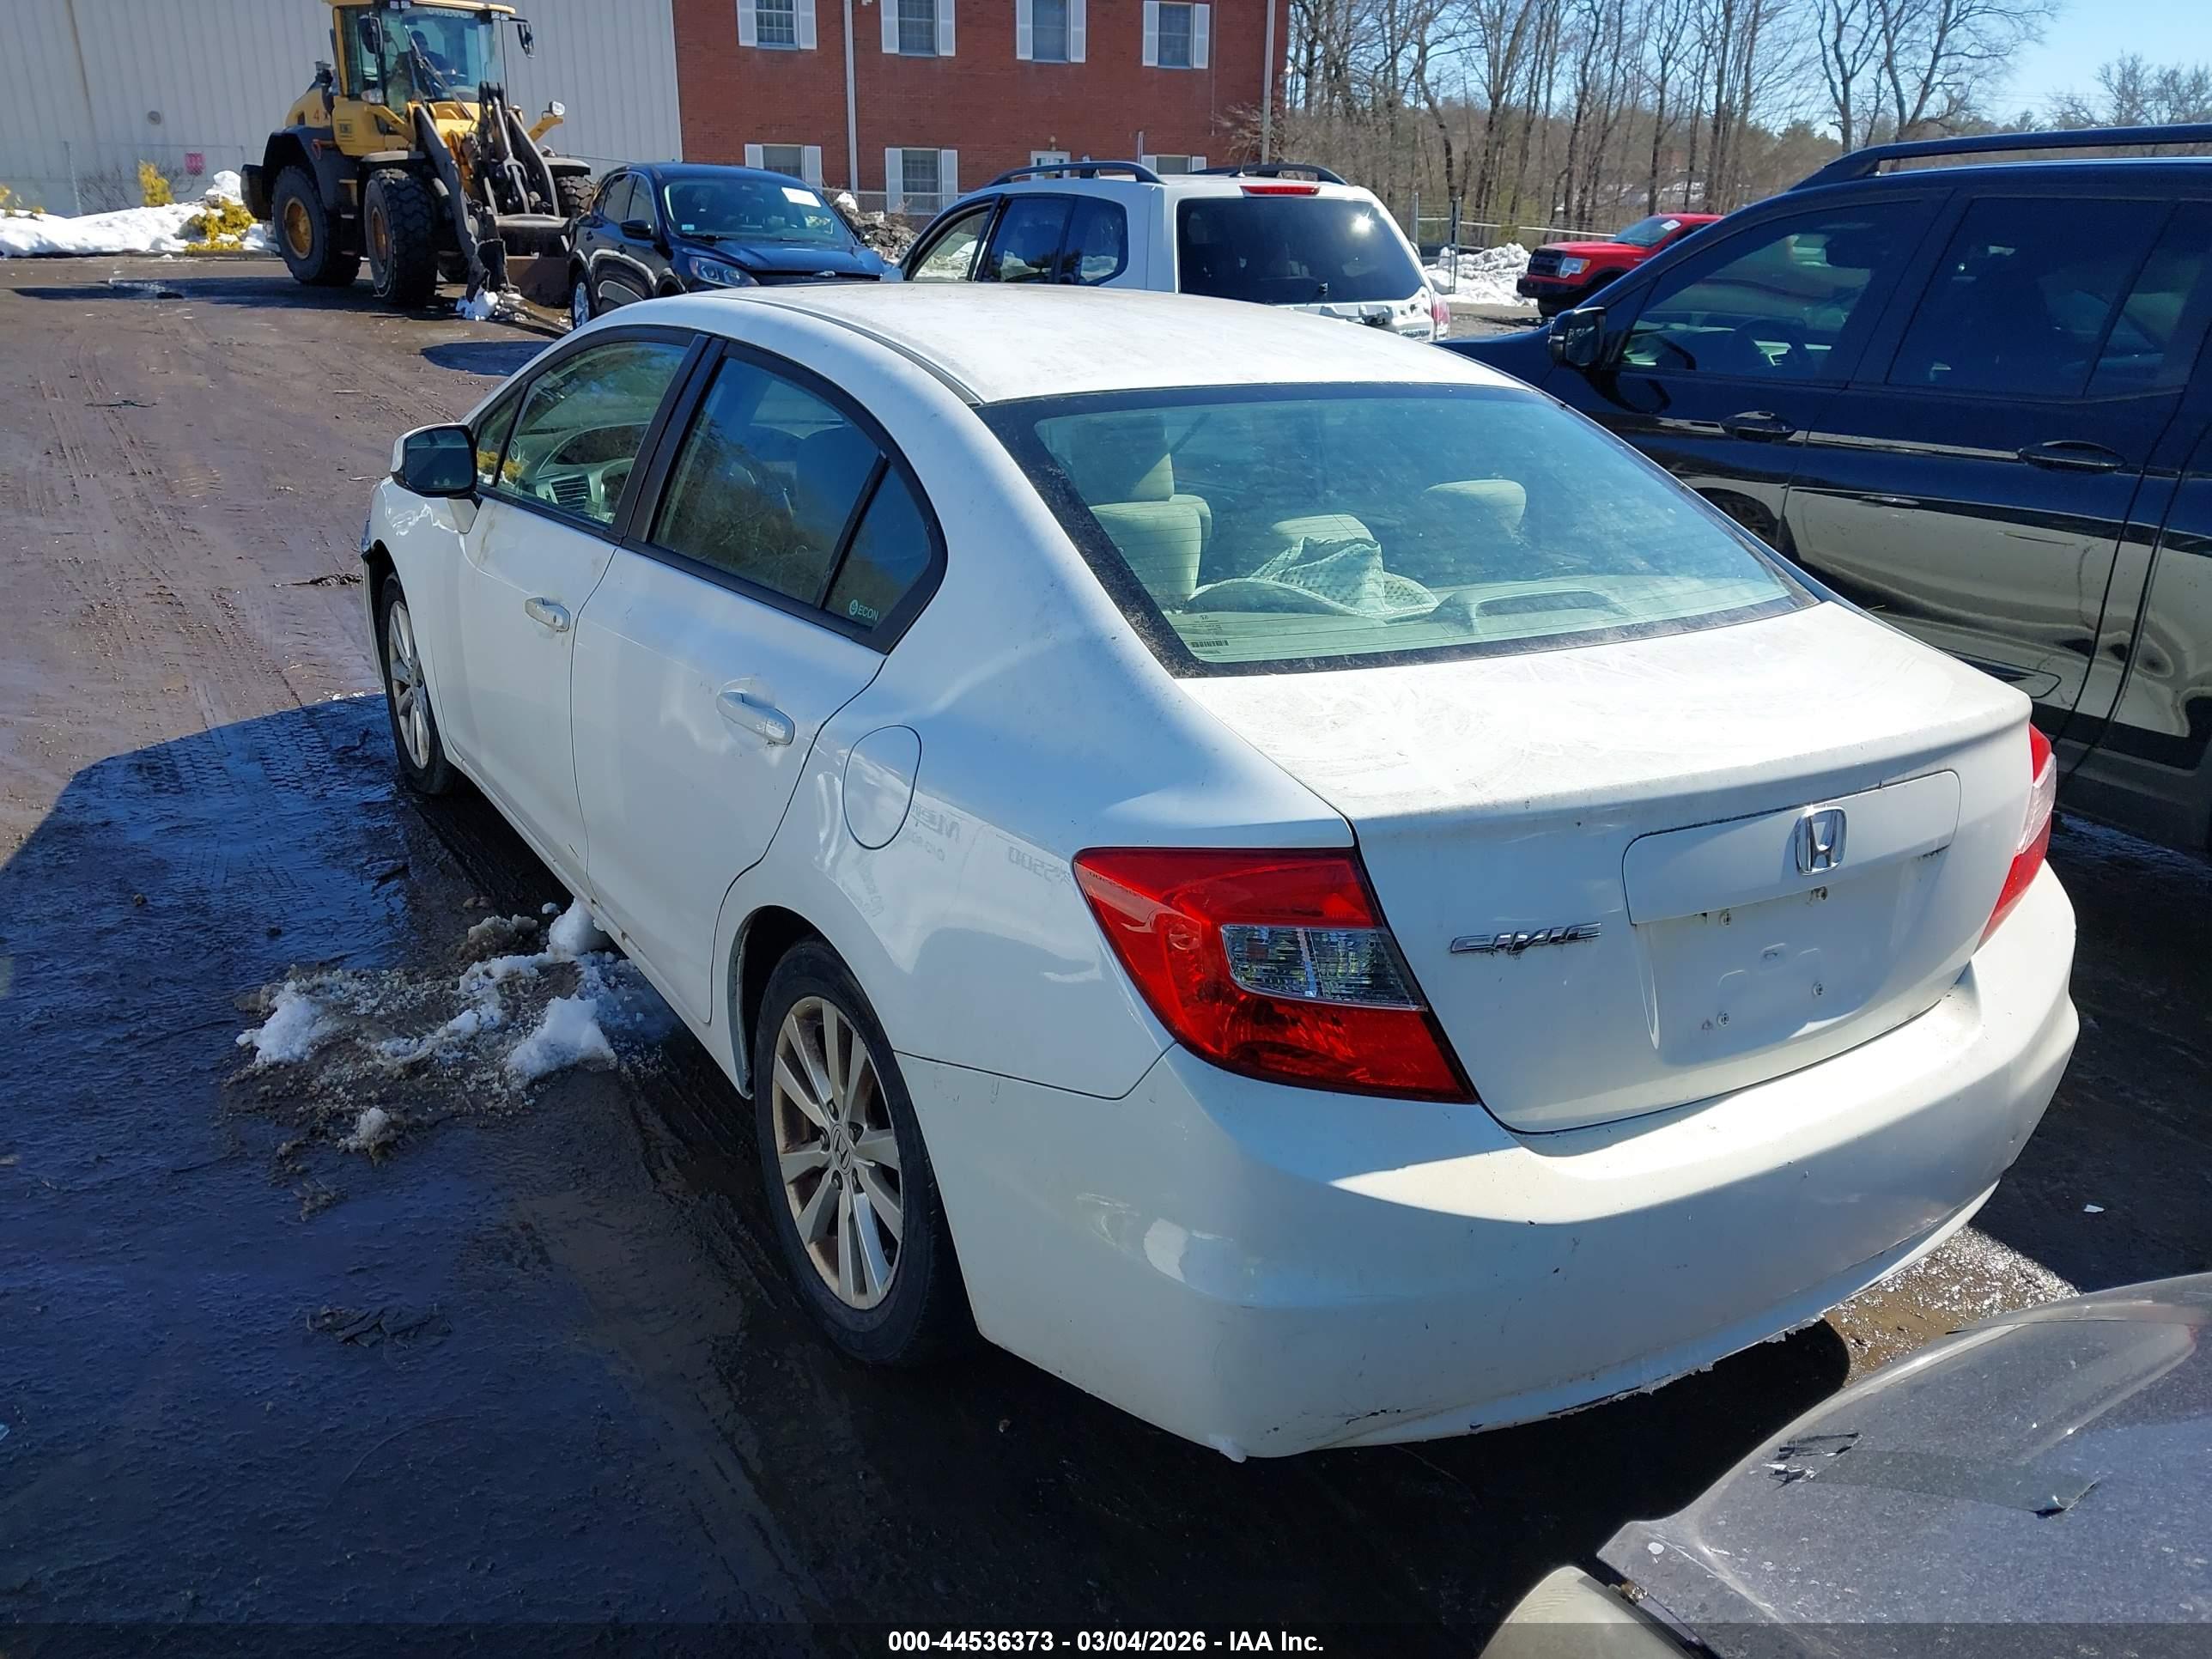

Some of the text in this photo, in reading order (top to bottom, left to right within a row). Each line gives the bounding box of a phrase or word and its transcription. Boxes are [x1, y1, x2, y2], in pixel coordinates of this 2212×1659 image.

[425, 7, 475, 19] VOLVO
[857, 605, 879, 621] ECON
[1449, 922, 1601, 954] CIVIC
